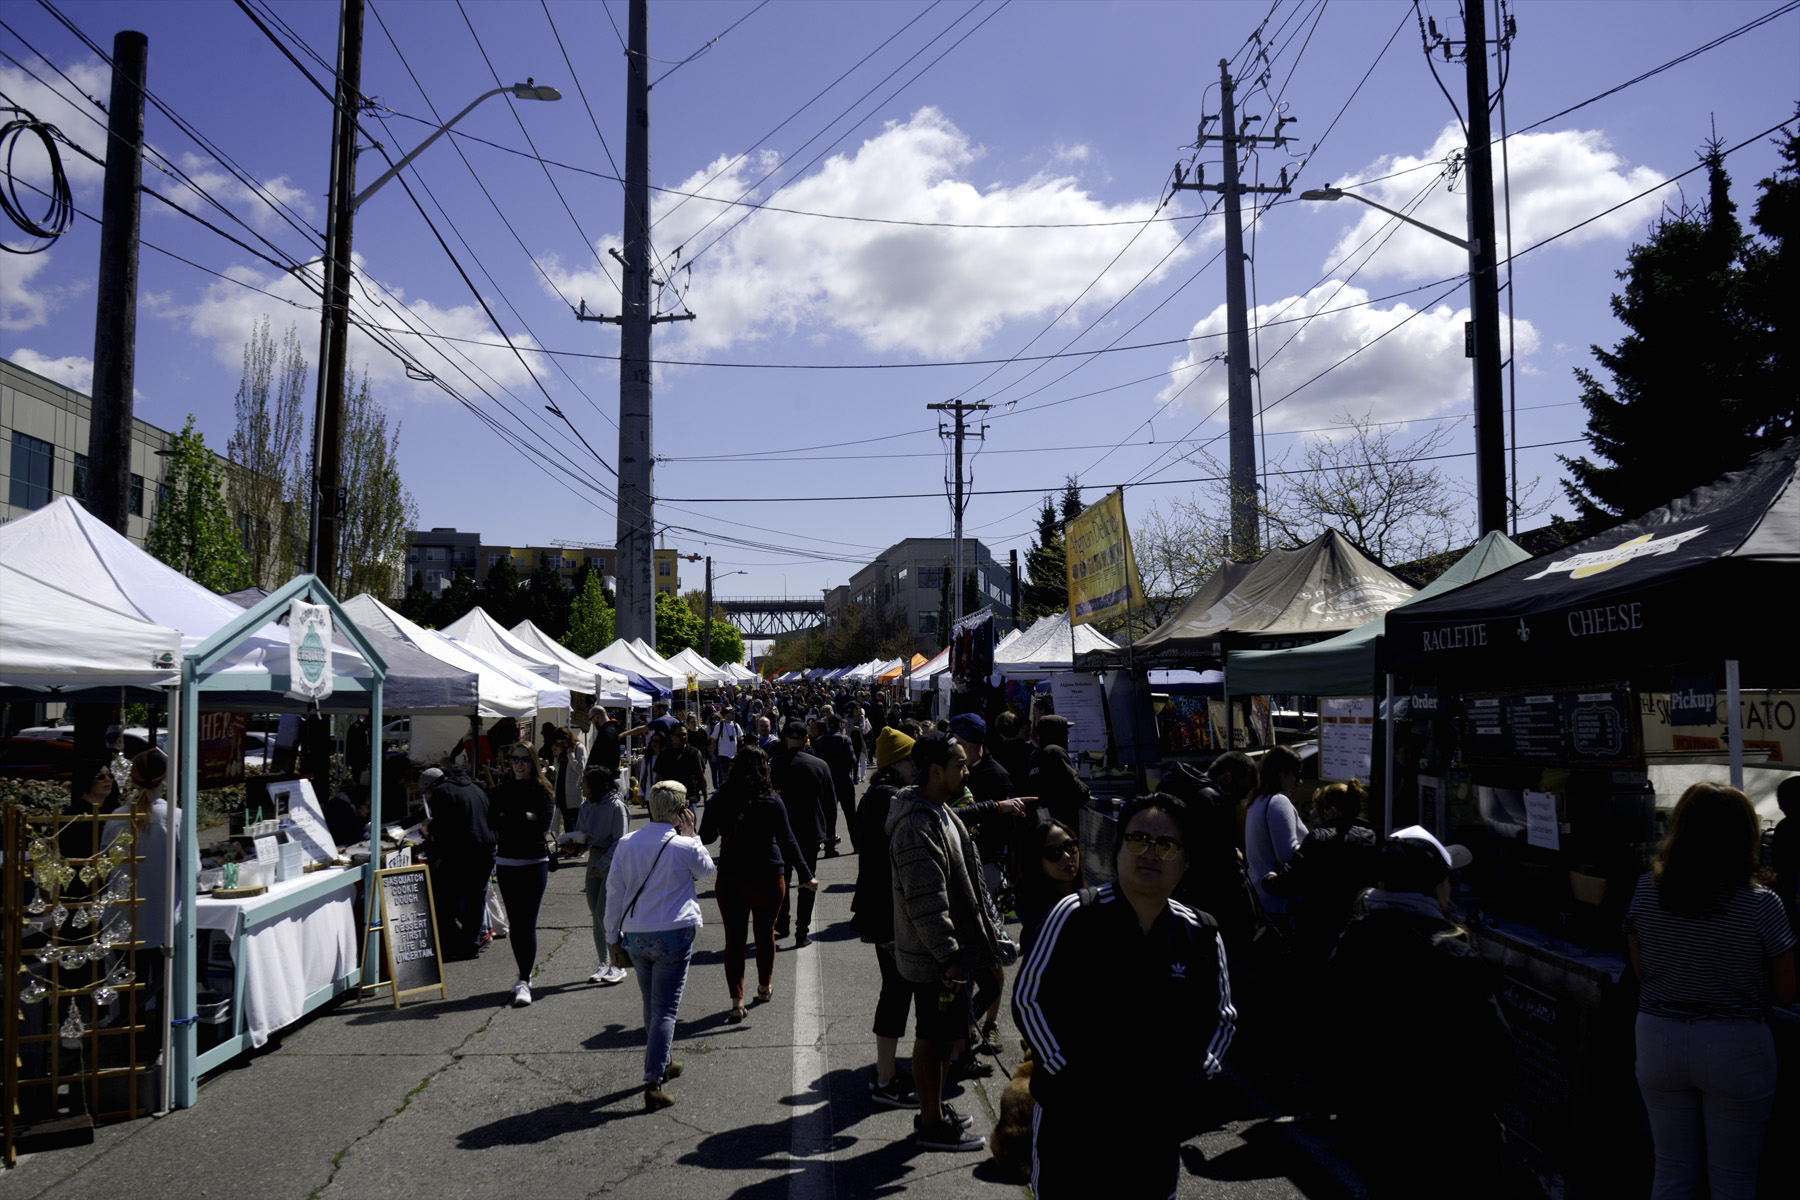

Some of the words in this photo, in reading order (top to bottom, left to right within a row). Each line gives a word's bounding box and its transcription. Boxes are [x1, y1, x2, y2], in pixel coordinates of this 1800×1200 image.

[336, 489, 346, 519] 814
[1302, 575, 1412, 601] SPEEDWARE
[1319, 604, 1396, 623] MOTORSP
[1423, 624, 1488, 652] RACLETTE
[1567, 602, 1644, 637] CHEESE
[1411, 693, 1439, 709] Order
[1671, 688, 1715, 713] Pickup
[382, 873, 425, 887] SASQUATCH
[392, 883, 419, 896] COOKIE
[395, 894, 418, 905] DOUGH
[395, 919, 427, 933] DESSERT
[399, 941, 415, 952] LIFE
[419, 939, 427, 948] IS
